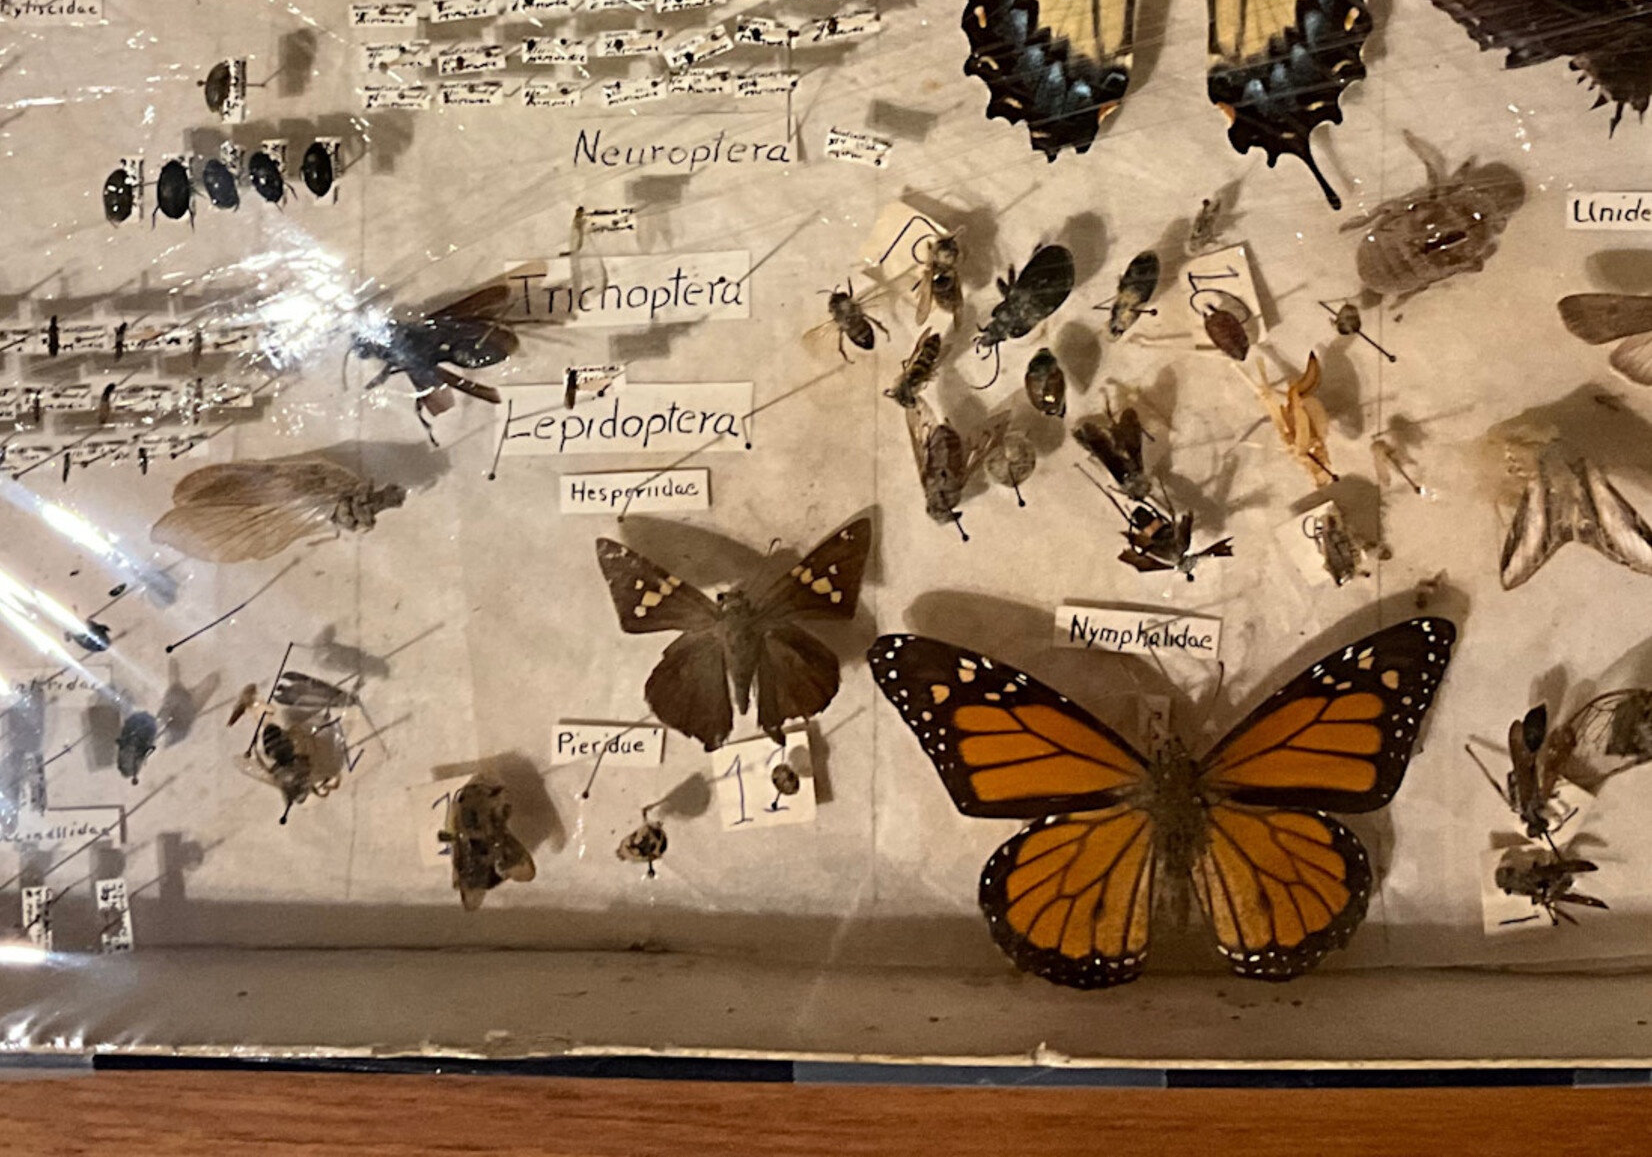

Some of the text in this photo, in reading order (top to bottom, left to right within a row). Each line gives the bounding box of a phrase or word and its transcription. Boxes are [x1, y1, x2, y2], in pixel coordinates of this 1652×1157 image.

[574, 129, 790, 172] Neuroptera
[1573, 196, 1652, 223] Unide
[508, 267, 742, 319] Trichoptera
[504, 398, 740, 452] Lepidoptera
[570, 479, 699, 507] Hesperiidae
[1070, 614, 1213, 651] Nymphalidae
